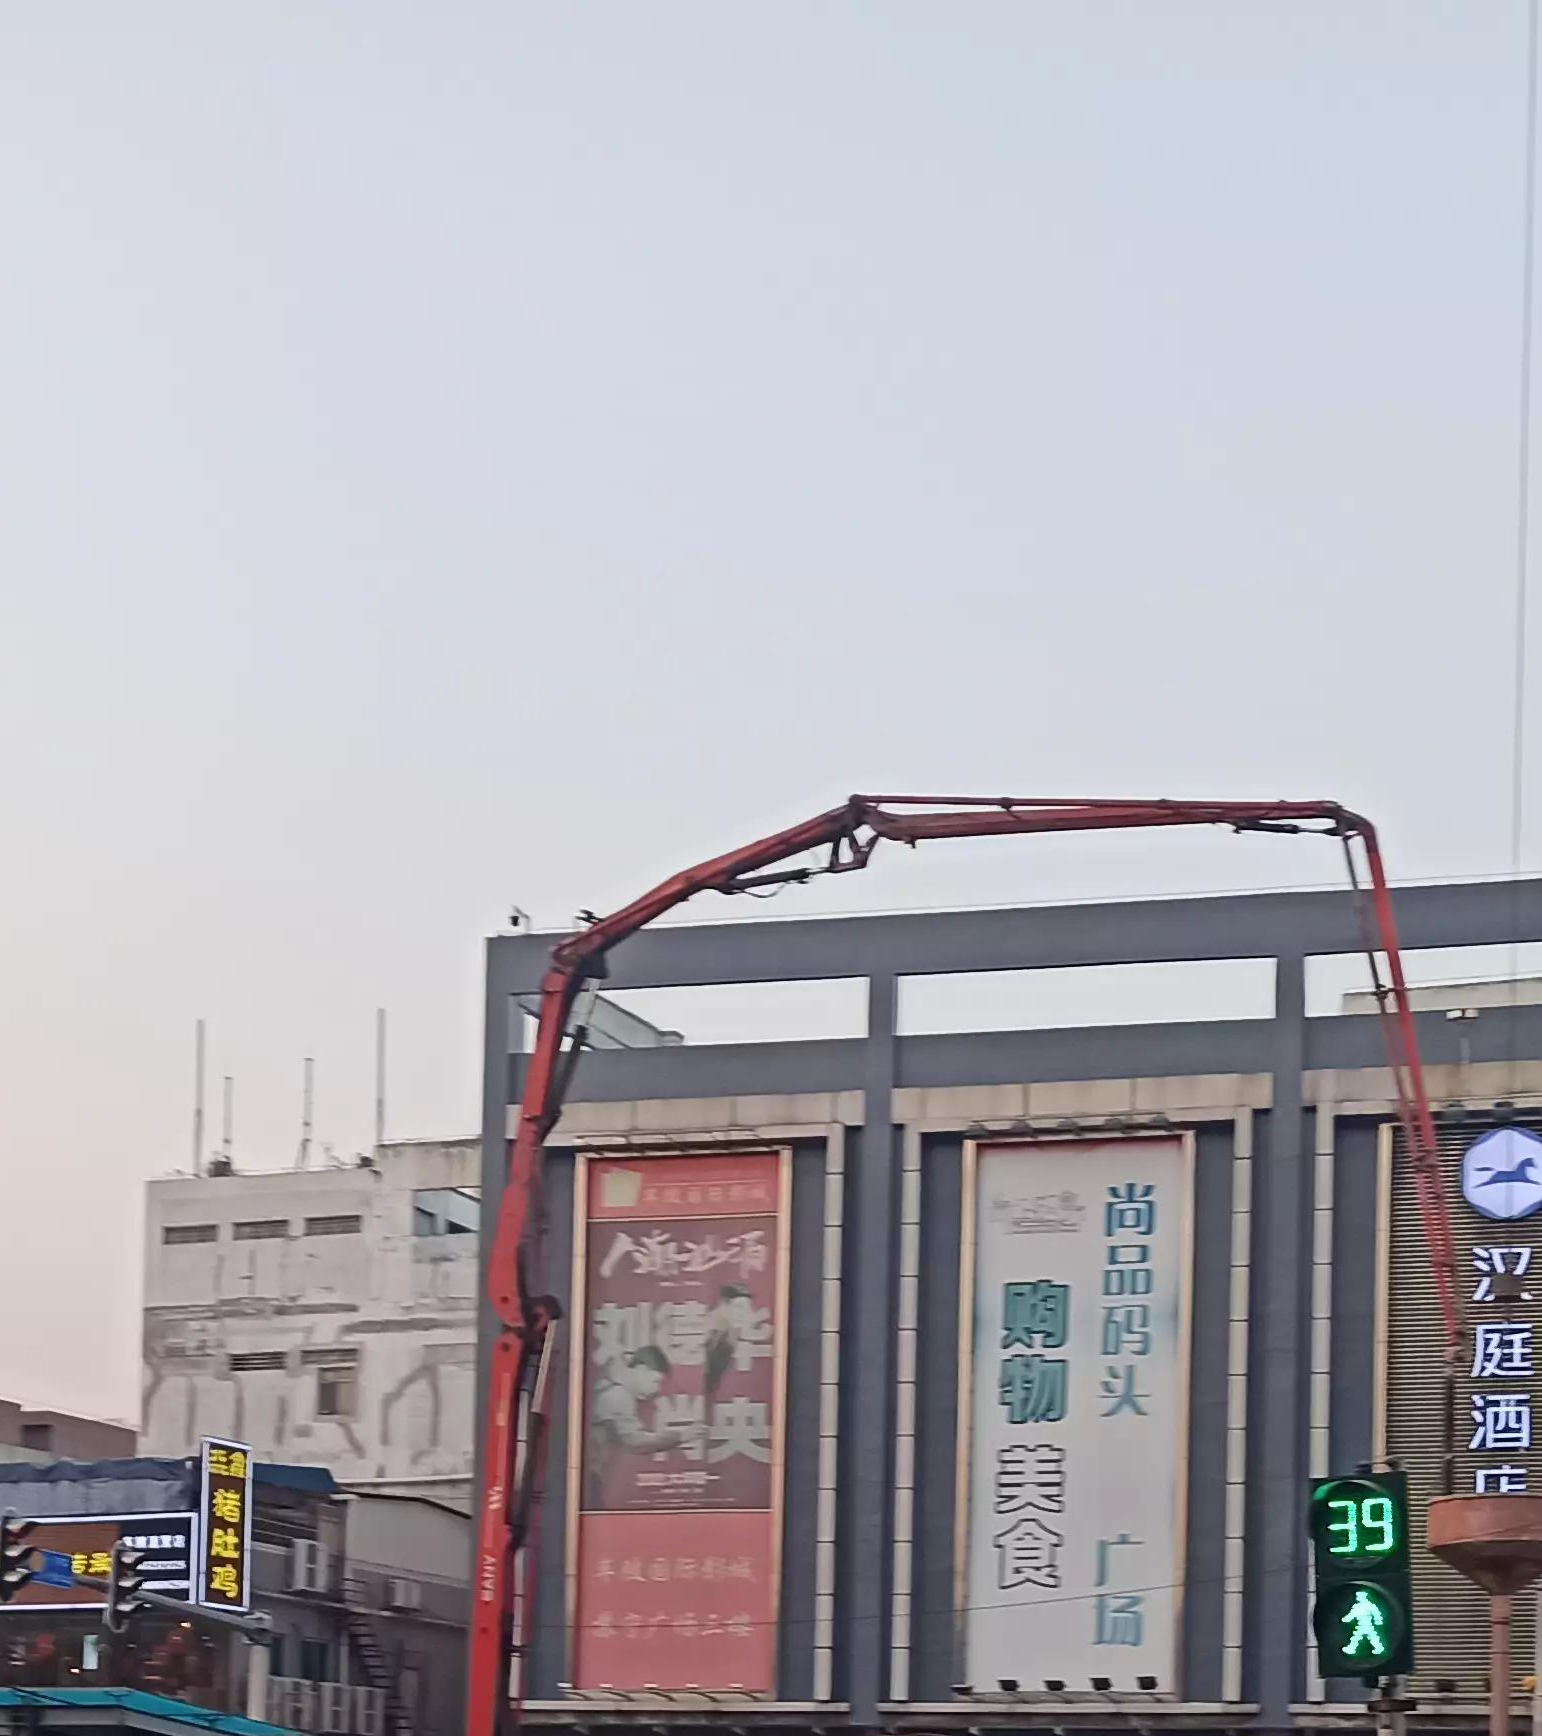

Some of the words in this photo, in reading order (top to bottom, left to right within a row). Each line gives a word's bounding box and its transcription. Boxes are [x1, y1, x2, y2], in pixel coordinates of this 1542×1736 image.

[1101, 1183, 1155, 1418] 尚品码头
[654, 1394, 774, 1463] 肖央
[211, 1488, 241, 1598] 猪肚鸡
[1328, 1497, 1394, 1553] 39
[1092, 1532, 1145, 1647] 广场
